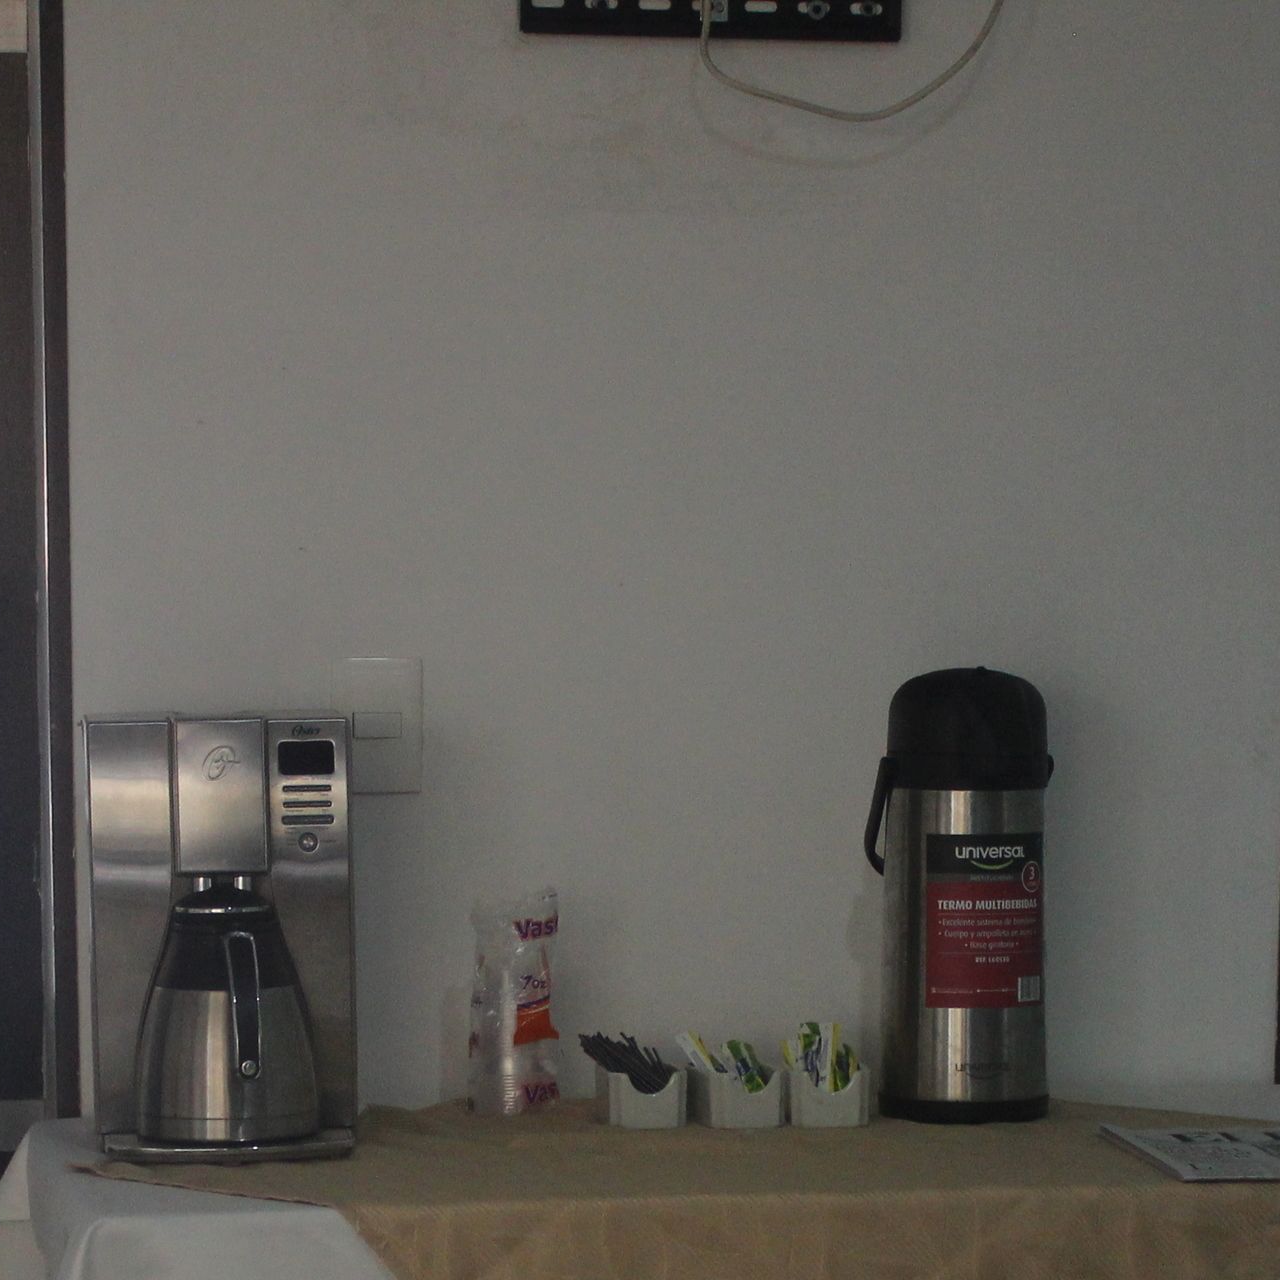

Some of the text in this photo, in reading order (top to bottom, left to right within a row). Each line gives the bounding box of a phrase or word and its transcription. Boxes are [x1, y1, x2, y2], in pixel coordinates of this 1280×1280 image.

[954, 846, 1025, 859] universal
[1028, 866, 1036, 880] 3
[937, 898, 1037, 910] TERMO MULTIBEBIDAS
